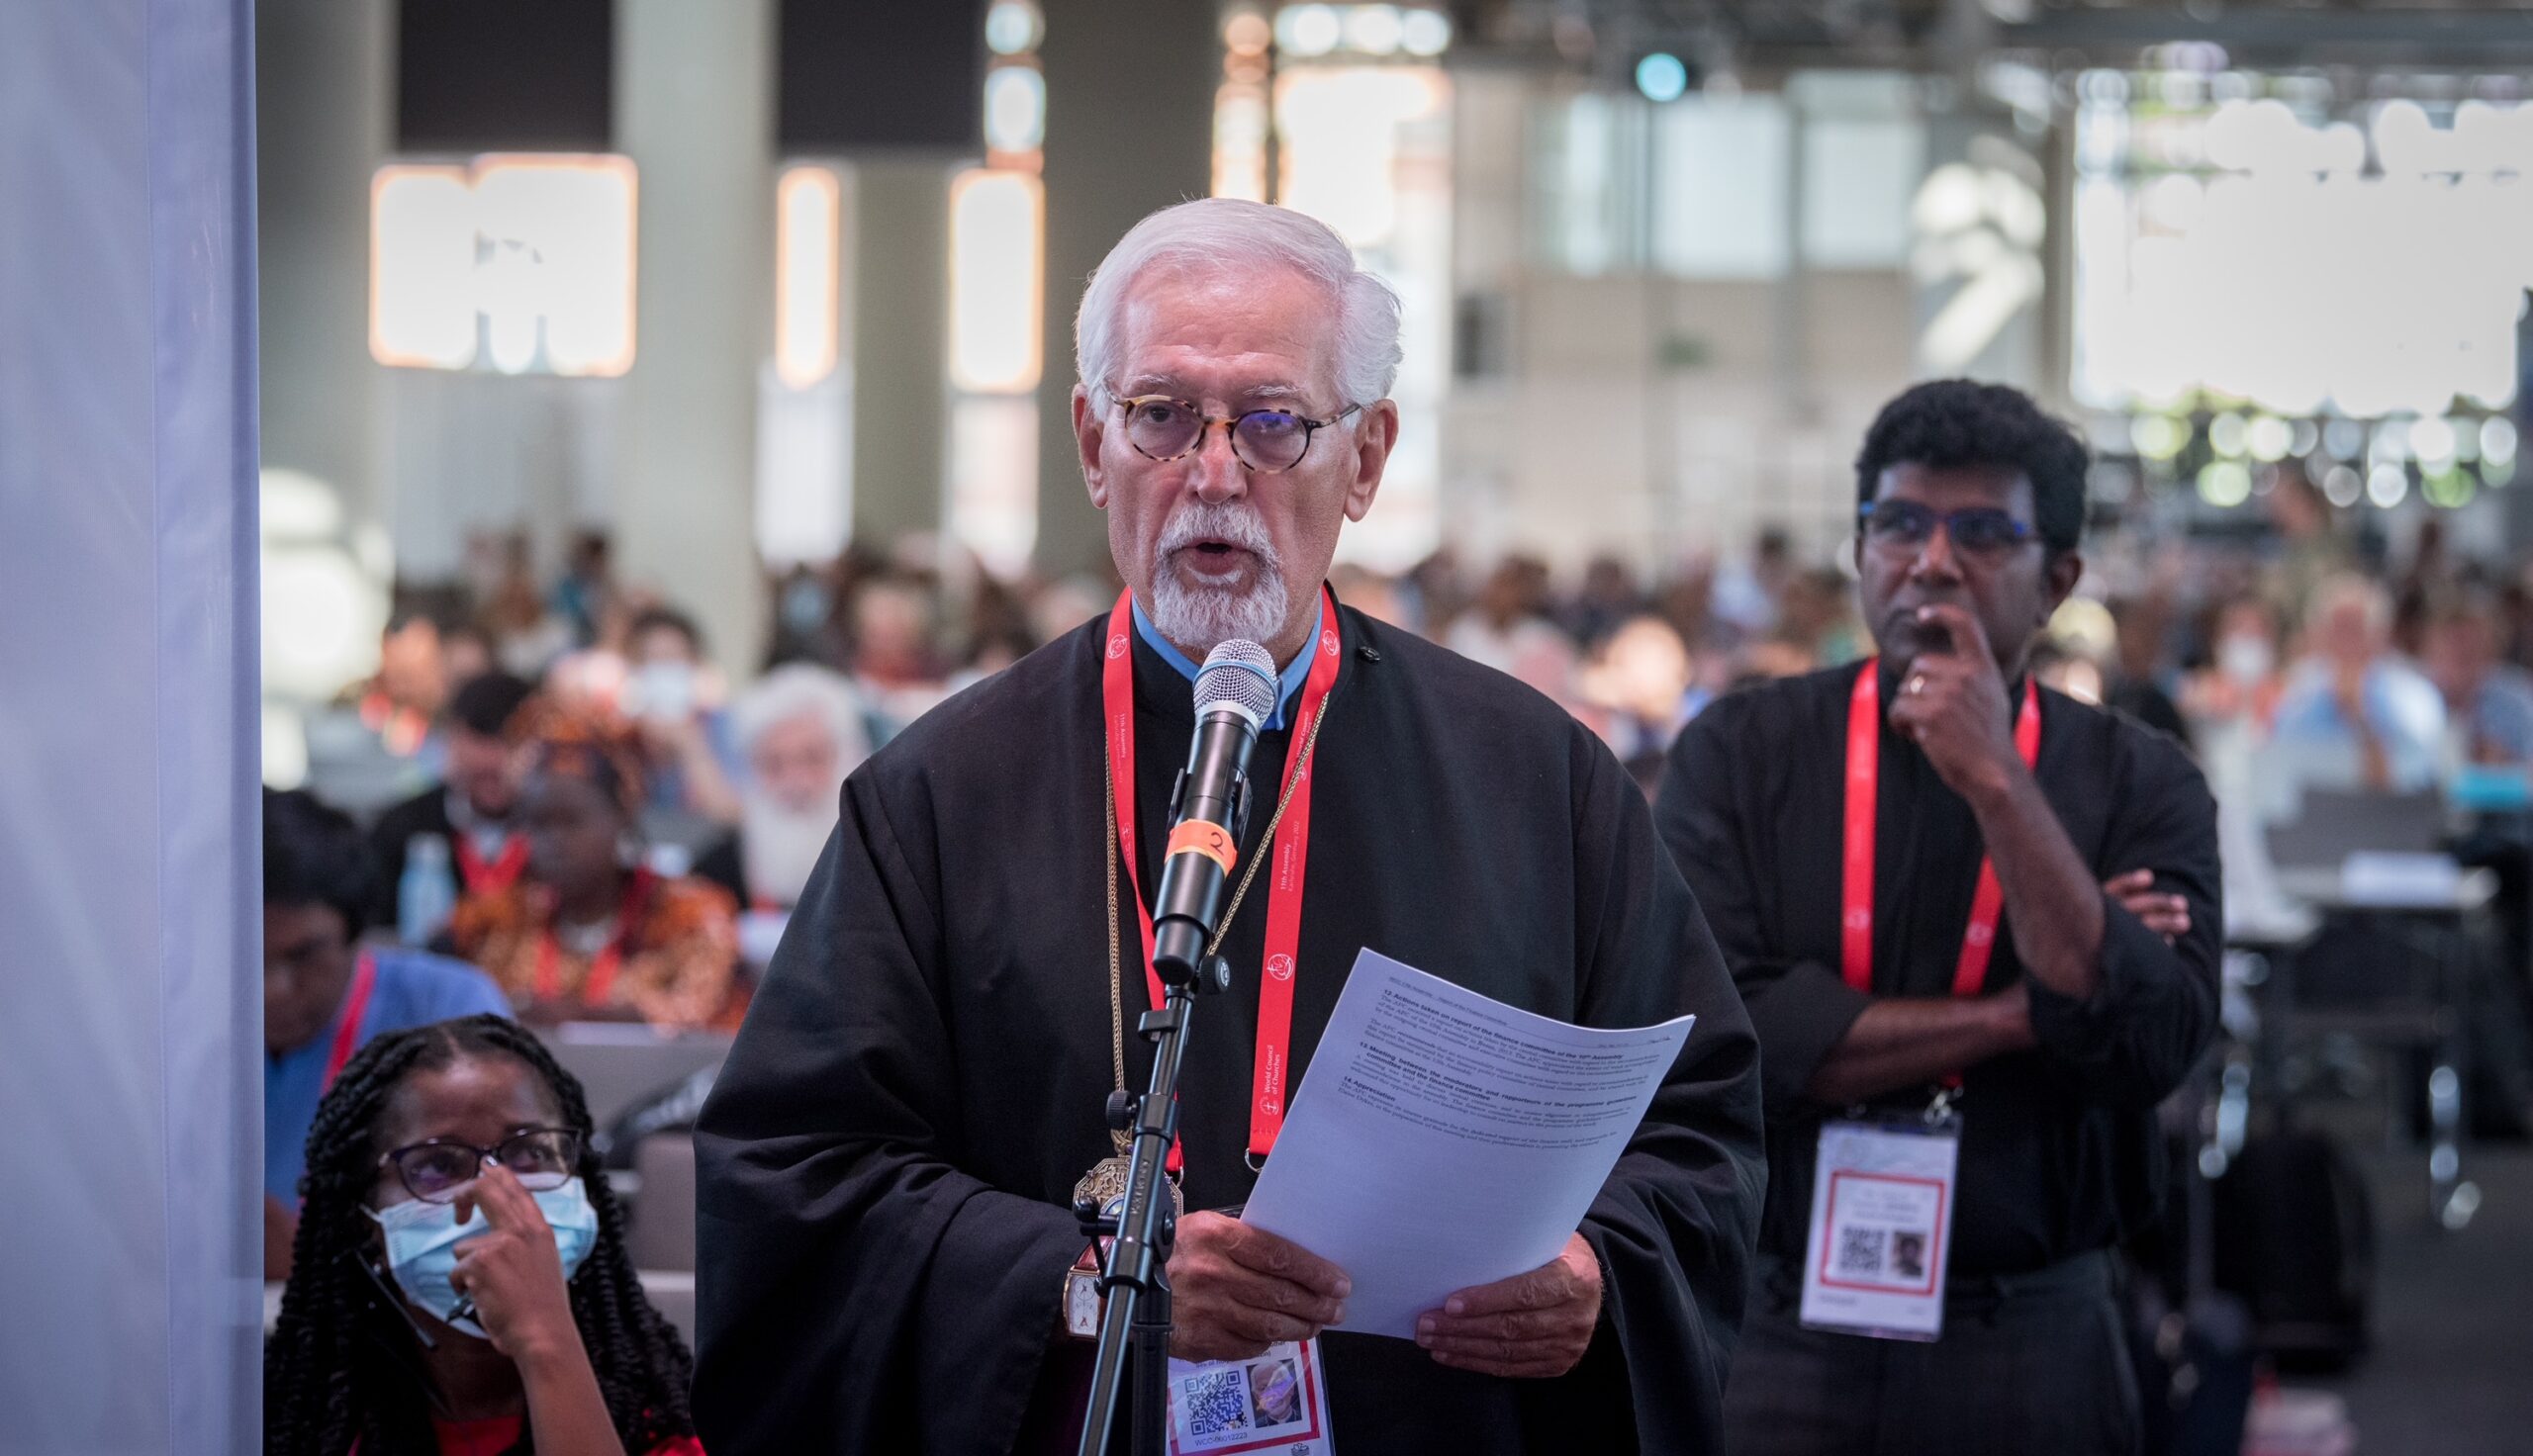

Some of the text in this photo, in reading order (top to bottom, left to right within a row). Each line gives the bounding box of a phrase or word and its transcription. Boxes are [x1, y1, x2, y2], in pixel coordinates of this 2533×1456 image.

[1209, 831, 1224, 856] 2
[1280, 843, 1292, 874] Assembly
[1421, 1004, 1440, 1016] taken
[1451, 1017, 1471, 1029] report
[1481, 1028, 1492, 1037] the
[1494, 1032, 1519, 1046] finance
[1520, 1042, 1555, 1055] committee
[1366, 1052, 1401, 1070] committee
[1402, 1067, 1416, 1076] and
[1416, 1072, 1428, 1081] the
[1429, 1077, 1454, 1090] finance
[1454, 1086, 1490, 1101] committee
[1369, 1046, 1396, 1061] Meeting
[1398, 1057, 1427, 1073] between
[1430, 1069, 1441, 1078] the
[1444, 1076, 1482, 1093] moderators
[1354, 1079, 1396, 1102] Appreciation
